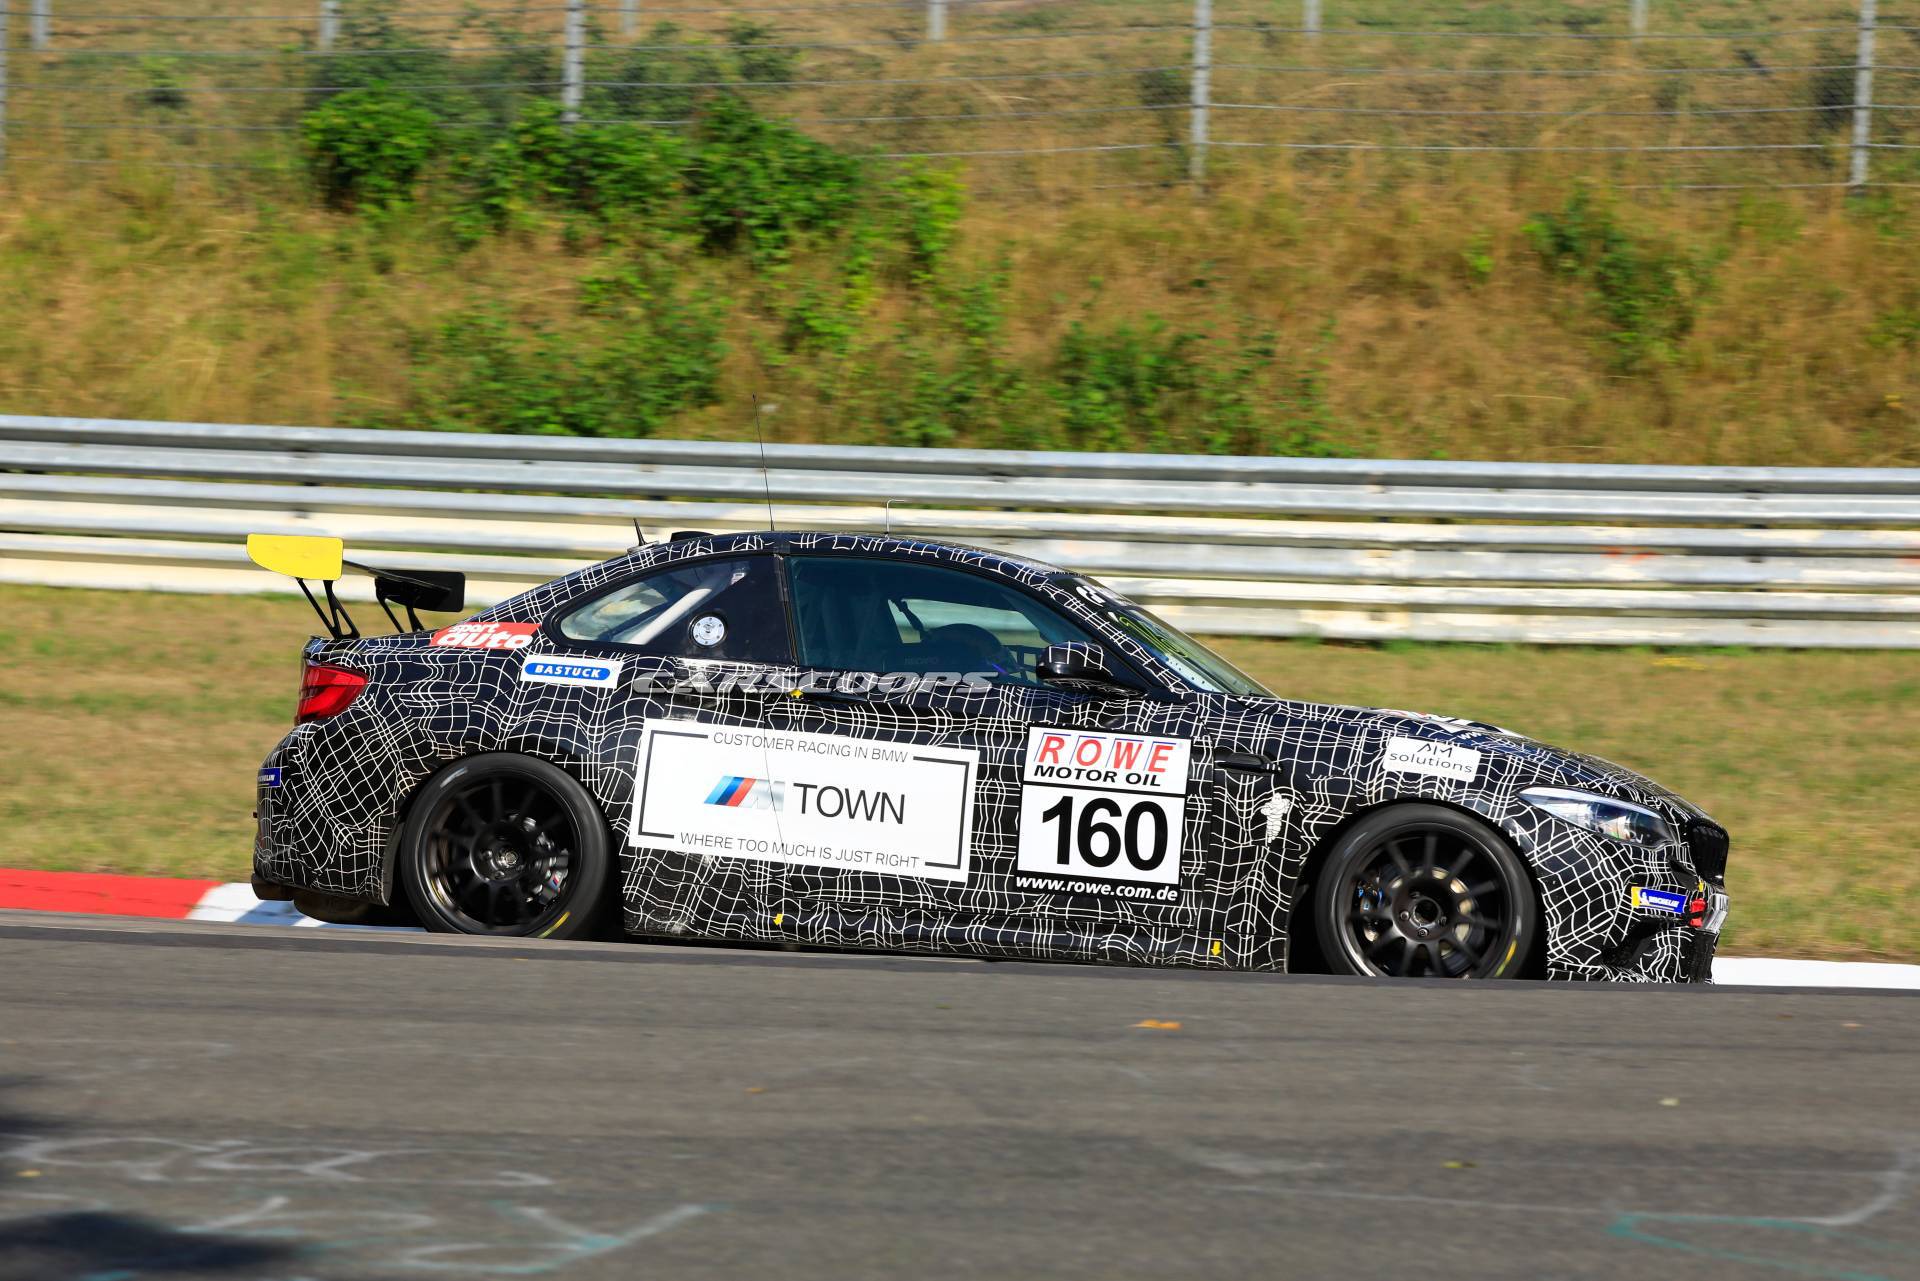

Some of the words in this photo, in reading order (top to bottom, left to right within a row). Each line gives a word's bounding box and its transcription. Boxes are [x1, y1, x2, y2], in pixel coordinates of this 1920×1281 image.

[436, 631, 534, 649] auto
[448, 623, 501, 634] sport
[534, 664, 601, 678] BASTUCK
[713, 732, 794, 751] CUSTOMER
[797, 742, 851, 757] RACING
[854, 746, 868, 759] IN
[871, 749, 908, 763] BMW
[1036, 735, 1175, 773] ROWE
[1389, 753, 1473, 773] solutions
[1033, 765, 1118, 783] MOTOR
[1125, 773, 1161, 787] OIL
[793, 782, 906, 825] TOWN
[1042, 795, 1168, 872] 160
[680, 832, 733, 849] WHERE
[737, 838, 769, 853] TOO
[772, 842, 816, 858] MUCH
[819, 847, 832, 860] IS
[836, 849, 873, 863] JUST
[875, 853, 920, 868] RIGHT
[1015, 876, 1179, 901] www.rowe.com.de
